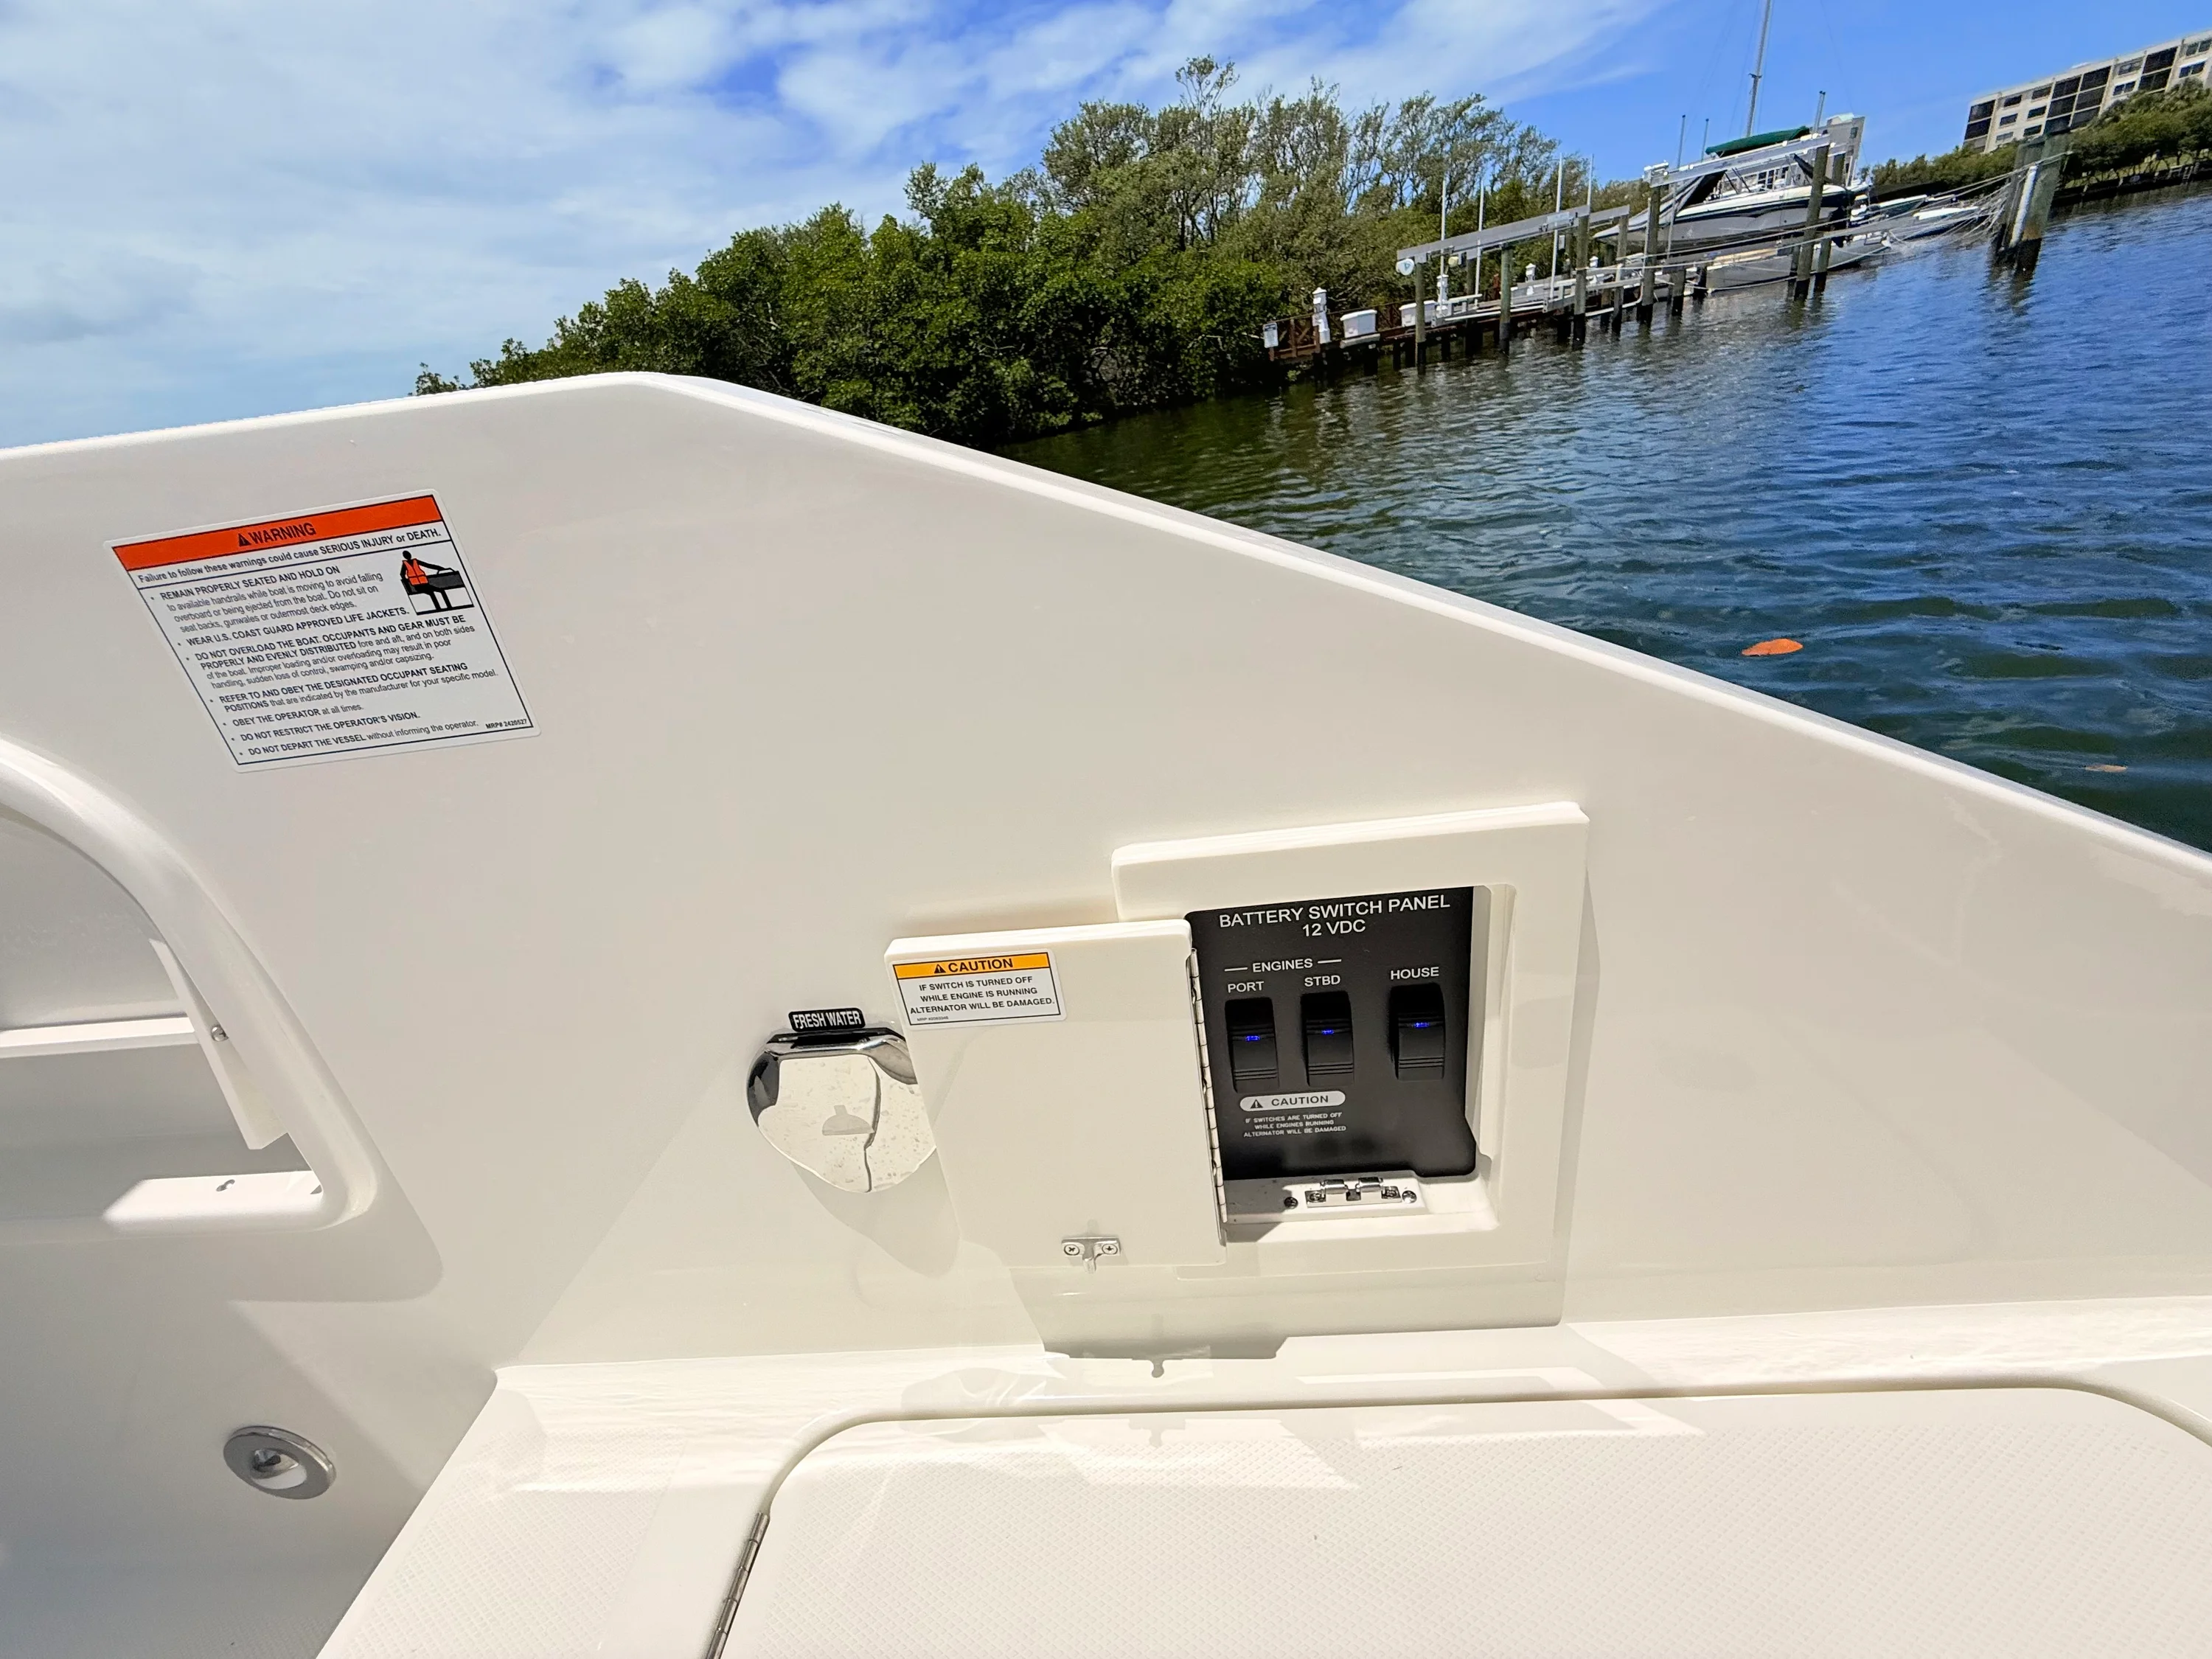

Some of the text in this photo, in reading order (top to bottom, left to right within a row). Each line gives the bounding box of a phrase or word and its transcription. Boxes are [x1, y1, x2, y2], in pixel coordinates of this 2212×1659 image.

[249, 524, 316, 544] WARNING
[137, 573, 167, 582] Failure
[177, 568, 204, 577] follow
[204, 563, 228, 573] these
[228, 557, 268, 568] warnings
[268, 552, 293, 563] could
[293, 549, 319, 559] cause
[319, 540, 361, 554] SERIOUS
[361, 535, 394, 548] INJURY
[396, 535, 406, 543] or
[406, 528, 442, 541] DEATH.
[159, 565, 341, 600] REMAIN PROPERLY SEATED AND HOLD ON
[173, 609, 213, 622] overboard
[220, 605, 246, 615] being
[244, 599, 274, 613] ejected
[273, 599, 293, 608] from
[292, 596, 307, 605] the
[305, 592, 328, 602] boat.
[327, 590, 341, 599] Do
[341, 588, 357, 597] not
[355, 586, 367, 595] sit
[366, 585, 379, 594] on
[186, 607, 410, 646] WEAR U.S. COAST GUARD APPROVED LIFE JACKETS.
[194, 614, 466, 661] DO NOT OVERLOAD THE BOAT. OCCUPANTS AND GEAR MUST BE
[200, 657, 245, 670] PROPERLY
[246, 654, 265, 664] AND
[265, 649, 298, 661] EVENLY
[299, 641, 357, 656] DISTRIBUTED
[357, 640, 374, 648] fore
[375, 636, 391, 645] and
[392, 634, 405, 643] aft,
[406, 632, 422, 641] and
[433, 627, 453, 637] both
[453, 625, 475, 634] sides
[206, 671, 215, 680] of
[227, 667, 248, 677] boat.
[247, 664, 282, 674] Improper
[281, 659, 312, 669] loading
[312, 655, 336, 665] and/or
[337, 649, 383, 661] overloading
[382, 647, 400, 655] may
[400, 642, 424, 653] result
[422, 641, 433, 649] in
[433, 639, 451, 650] poor
[219, 662, 468, 703] REFER TO AND OBEY THE DESIGNATED OCCUPANT SEATING
[223, 700, 269, 712] POSITIONS
[269, 698, 285, 706] that
[298, 691, 334, 703] indicated
[333, 690, 344, 699] by
[358, 682, 408, 695] manufacturer
[421, 678, 439, 687] your
[440, 672, 471, 684] specific
[471, 669, 499, 679] model.
[232, 717, 255, 726] OBEY
[255, 714, 275, 723] THE
[274, 708, 321, 721] OPERATOR
[330, 706, 341, 714] all
[340, 704, 364, 712] times.
[240, 712, 420, 741] DO NOT RESTRICT THE OPERATOR'S VISION.
[248, 720, 479, 756] DO NOT DEPART THE VESSEL without informing the operator.
[1219, 894, 1450, 927] BATTERY SWITCH PANEL
[1302, 919, 1366, 936] 12 VDC
[947, 958, 1013, 973] CAUTION
[1252, 958, 1313, 973] ENGINES
[1391, 966, 1439, 980] HOUSE
[928, 981, 964, 990] SWITCH
[975, 978, 1013, 987] TURNED
[1015, 975, 1032, 984] OFF
[1227, 981, 1265, 993] PORT
[1304, 975, 1340, 987] STBD
[919, 994, 949, 1002] WHILE
[950, 991, 984, 1000] ENGINE
[995, 987, 1037, 997] RUNNING
[910, 1004, 967, 1014] ALTERNATOR
[1006, 998, 1054, 1007] DAMAGED.
[793, 1010, 862, 1029] FRESH WATER
[1271, 1095, 1329, 1107] CAUTION
